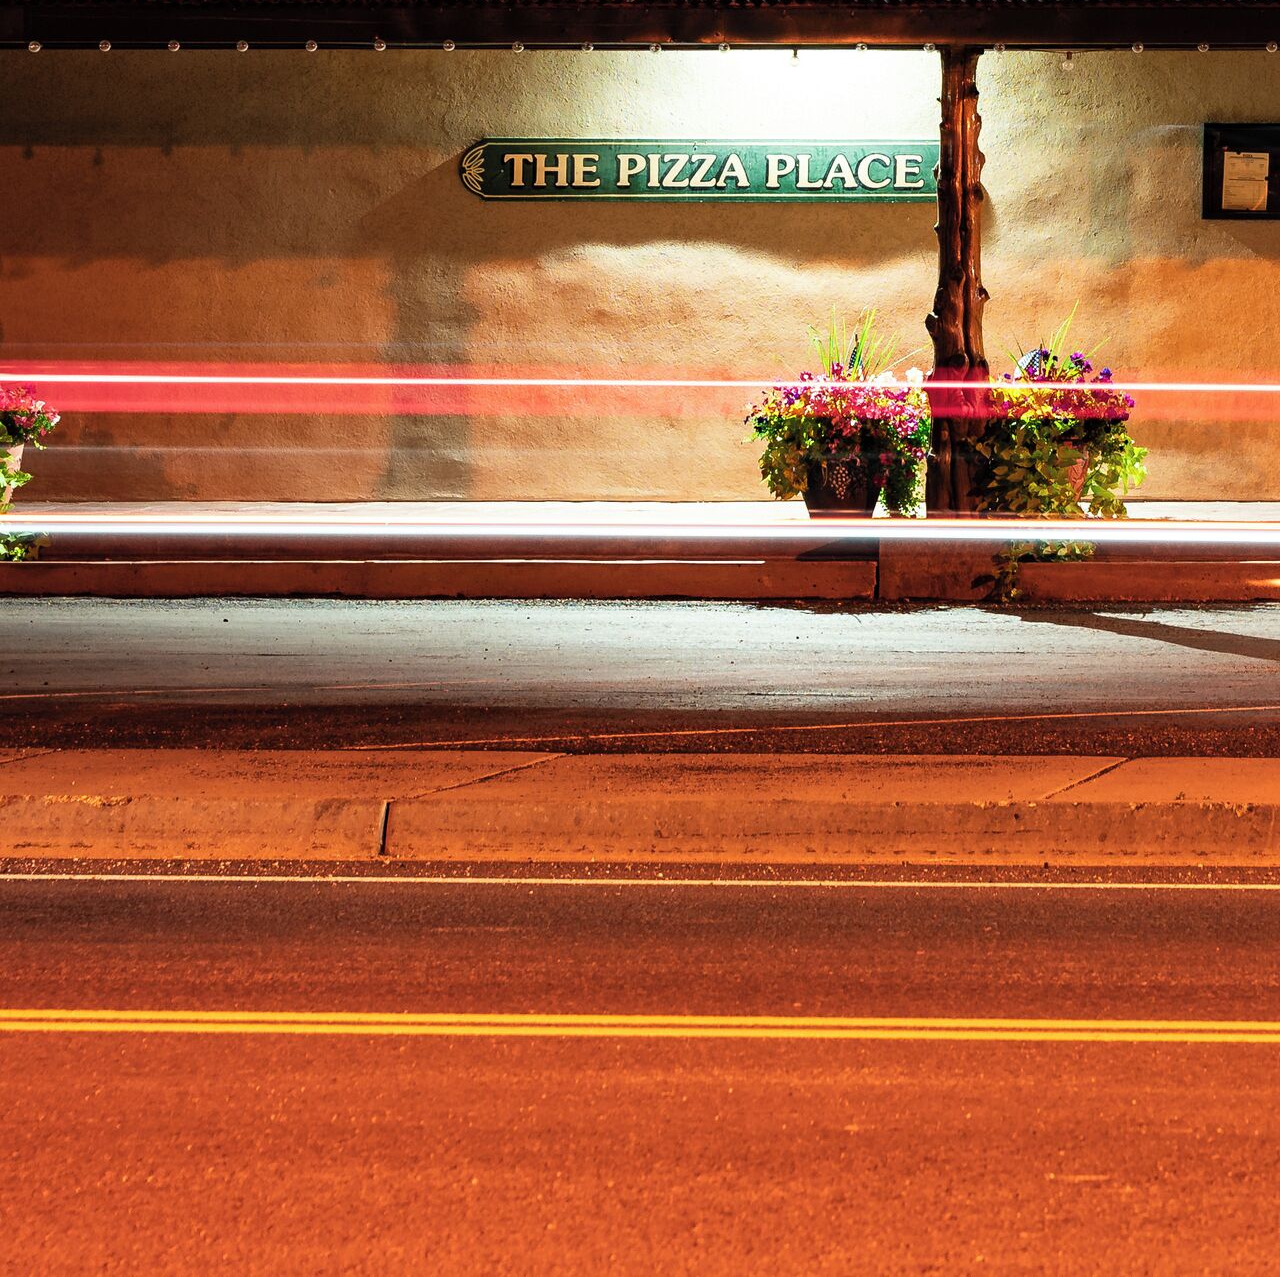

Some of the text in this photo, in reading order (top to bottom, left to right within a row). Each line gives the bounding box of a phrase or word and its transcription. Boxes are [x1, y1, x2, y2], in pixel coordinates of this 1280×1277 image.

[503, 152, 926, 191] THE PIZZA PLACE
